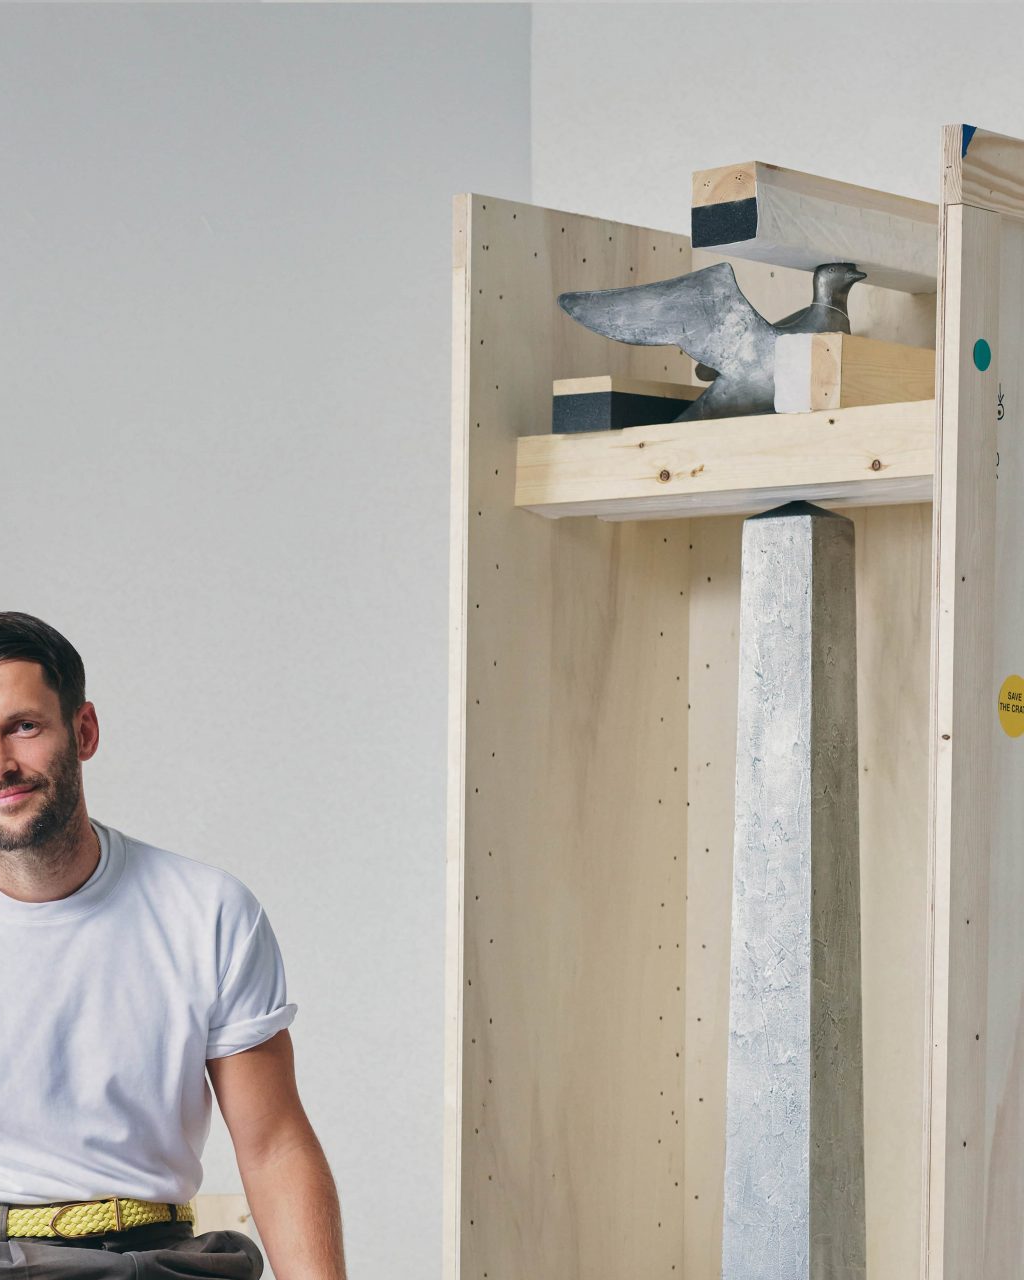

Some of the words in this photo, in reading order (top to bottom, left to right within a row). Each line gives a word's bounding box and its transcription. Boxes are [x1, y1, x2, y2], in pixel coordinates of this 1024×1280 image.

[1007, 691, 1022, 702] SAVE
[1000, 702, 1010, 712] THE
[1012, 704, 1024, 714] CRA
